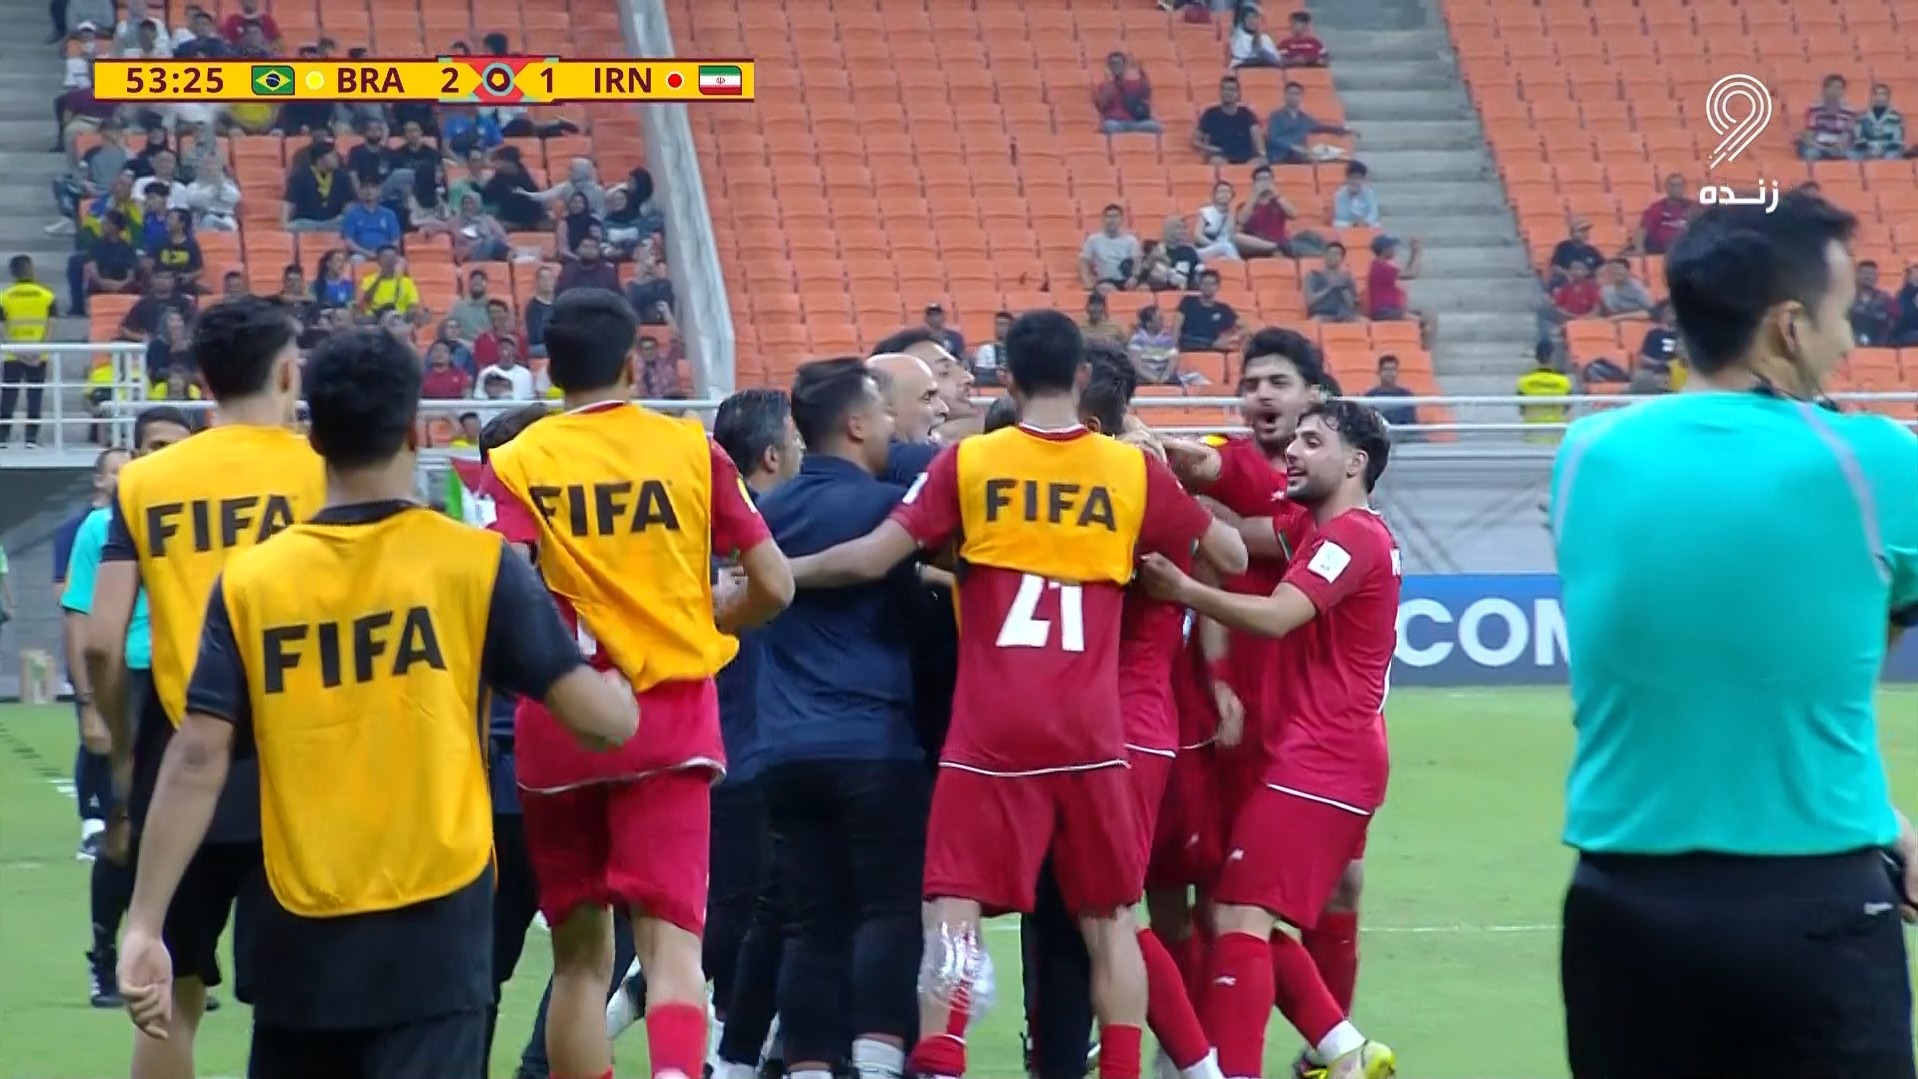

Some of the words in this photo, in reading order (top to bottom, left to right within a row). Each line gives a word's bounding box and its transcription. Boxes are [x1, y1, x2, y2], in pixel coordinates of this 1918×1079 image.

[146, 494, 295, 557] FIFA
[528, 479, 681, 537] FIFA
[985, 478, 1117, 532] FIFA
[262, 605, 447, 695] FIFA
